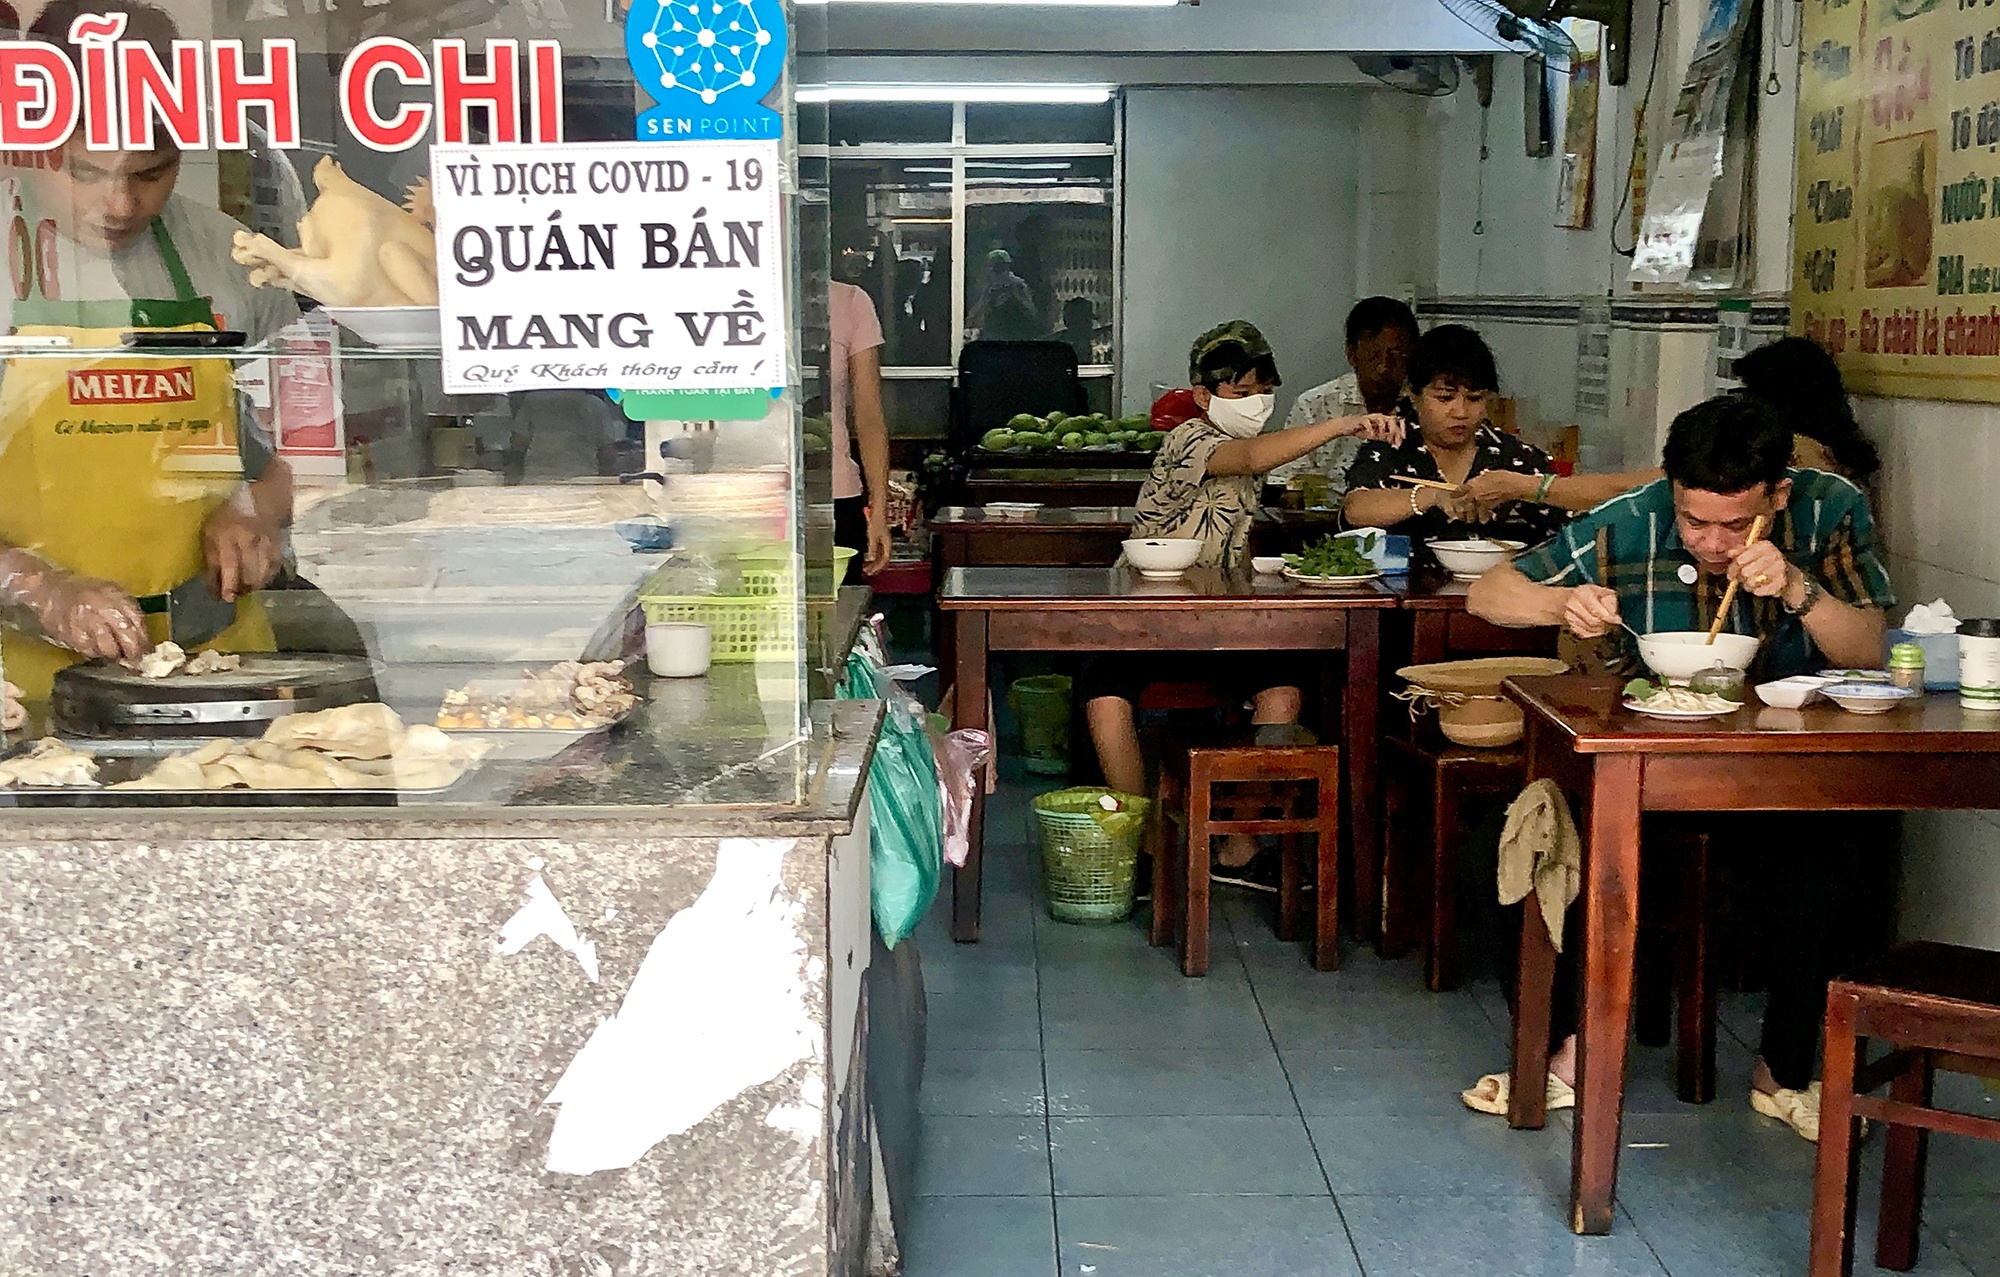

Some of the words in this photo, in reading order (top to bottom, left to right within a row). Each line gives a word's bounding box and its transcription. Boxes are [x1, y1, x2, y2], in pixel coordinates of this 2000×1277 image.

[0, 12, 301, 151] ĐĨNH
[339, 35, 564, 153] CHI
[647, 118, 692, 134] SEN
[701, 117, 771, 134] POINT
[447, 155, 481, 196] VÌ
[493, 163, 576, 203] DỊCH
[589, 161, 688, 193] COVID
[727, 159, 761, 190] 19
[453, 210, 617, 287] QUÁN
[641, 207, 762, 268] BÁN
[457, 313, 653, 350] MANG
[676, 290, 765, 346] VỀ
[72, 370, 194, 400] MEIZAN
[463, 363, 519, 383] Quý
[531, 362, 608, 381] Khách
[621, 362, 681, 380] thông
[693, 361, 739, 376] cảm
